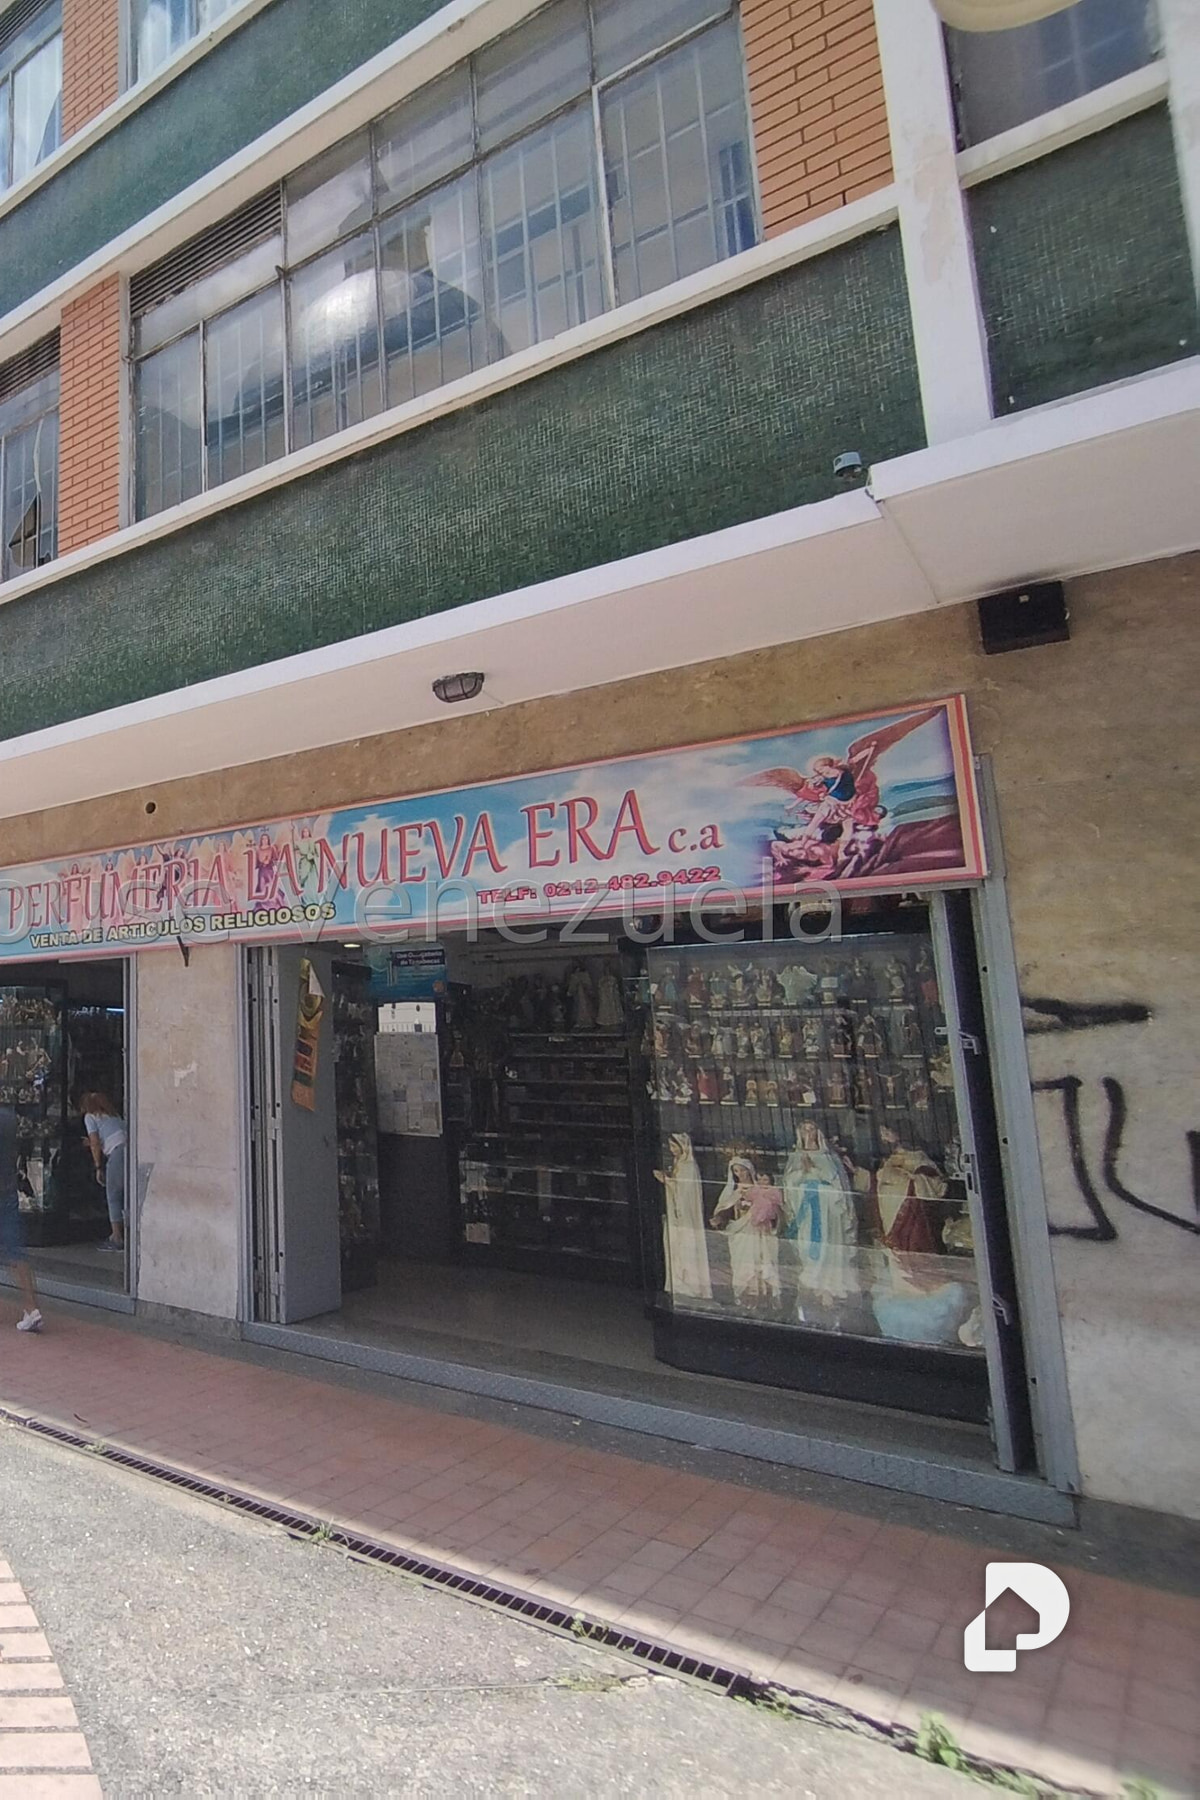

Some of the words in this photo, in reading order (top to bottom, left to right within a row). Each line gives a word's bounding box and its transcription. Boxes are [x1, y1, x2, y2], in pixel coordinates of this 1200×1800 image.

[315, 812, 508, 893] NUEVA
[519, 789, 661, 869] ERA
[477, 886, 537, 904] TELF:
[30, 931, 80, 949] VENTA
[82, 927, 103, 944] DE
[107, 915, 205, 942] ARTICULOS
[210, 902, 336, 931] RELIGIOSOS
